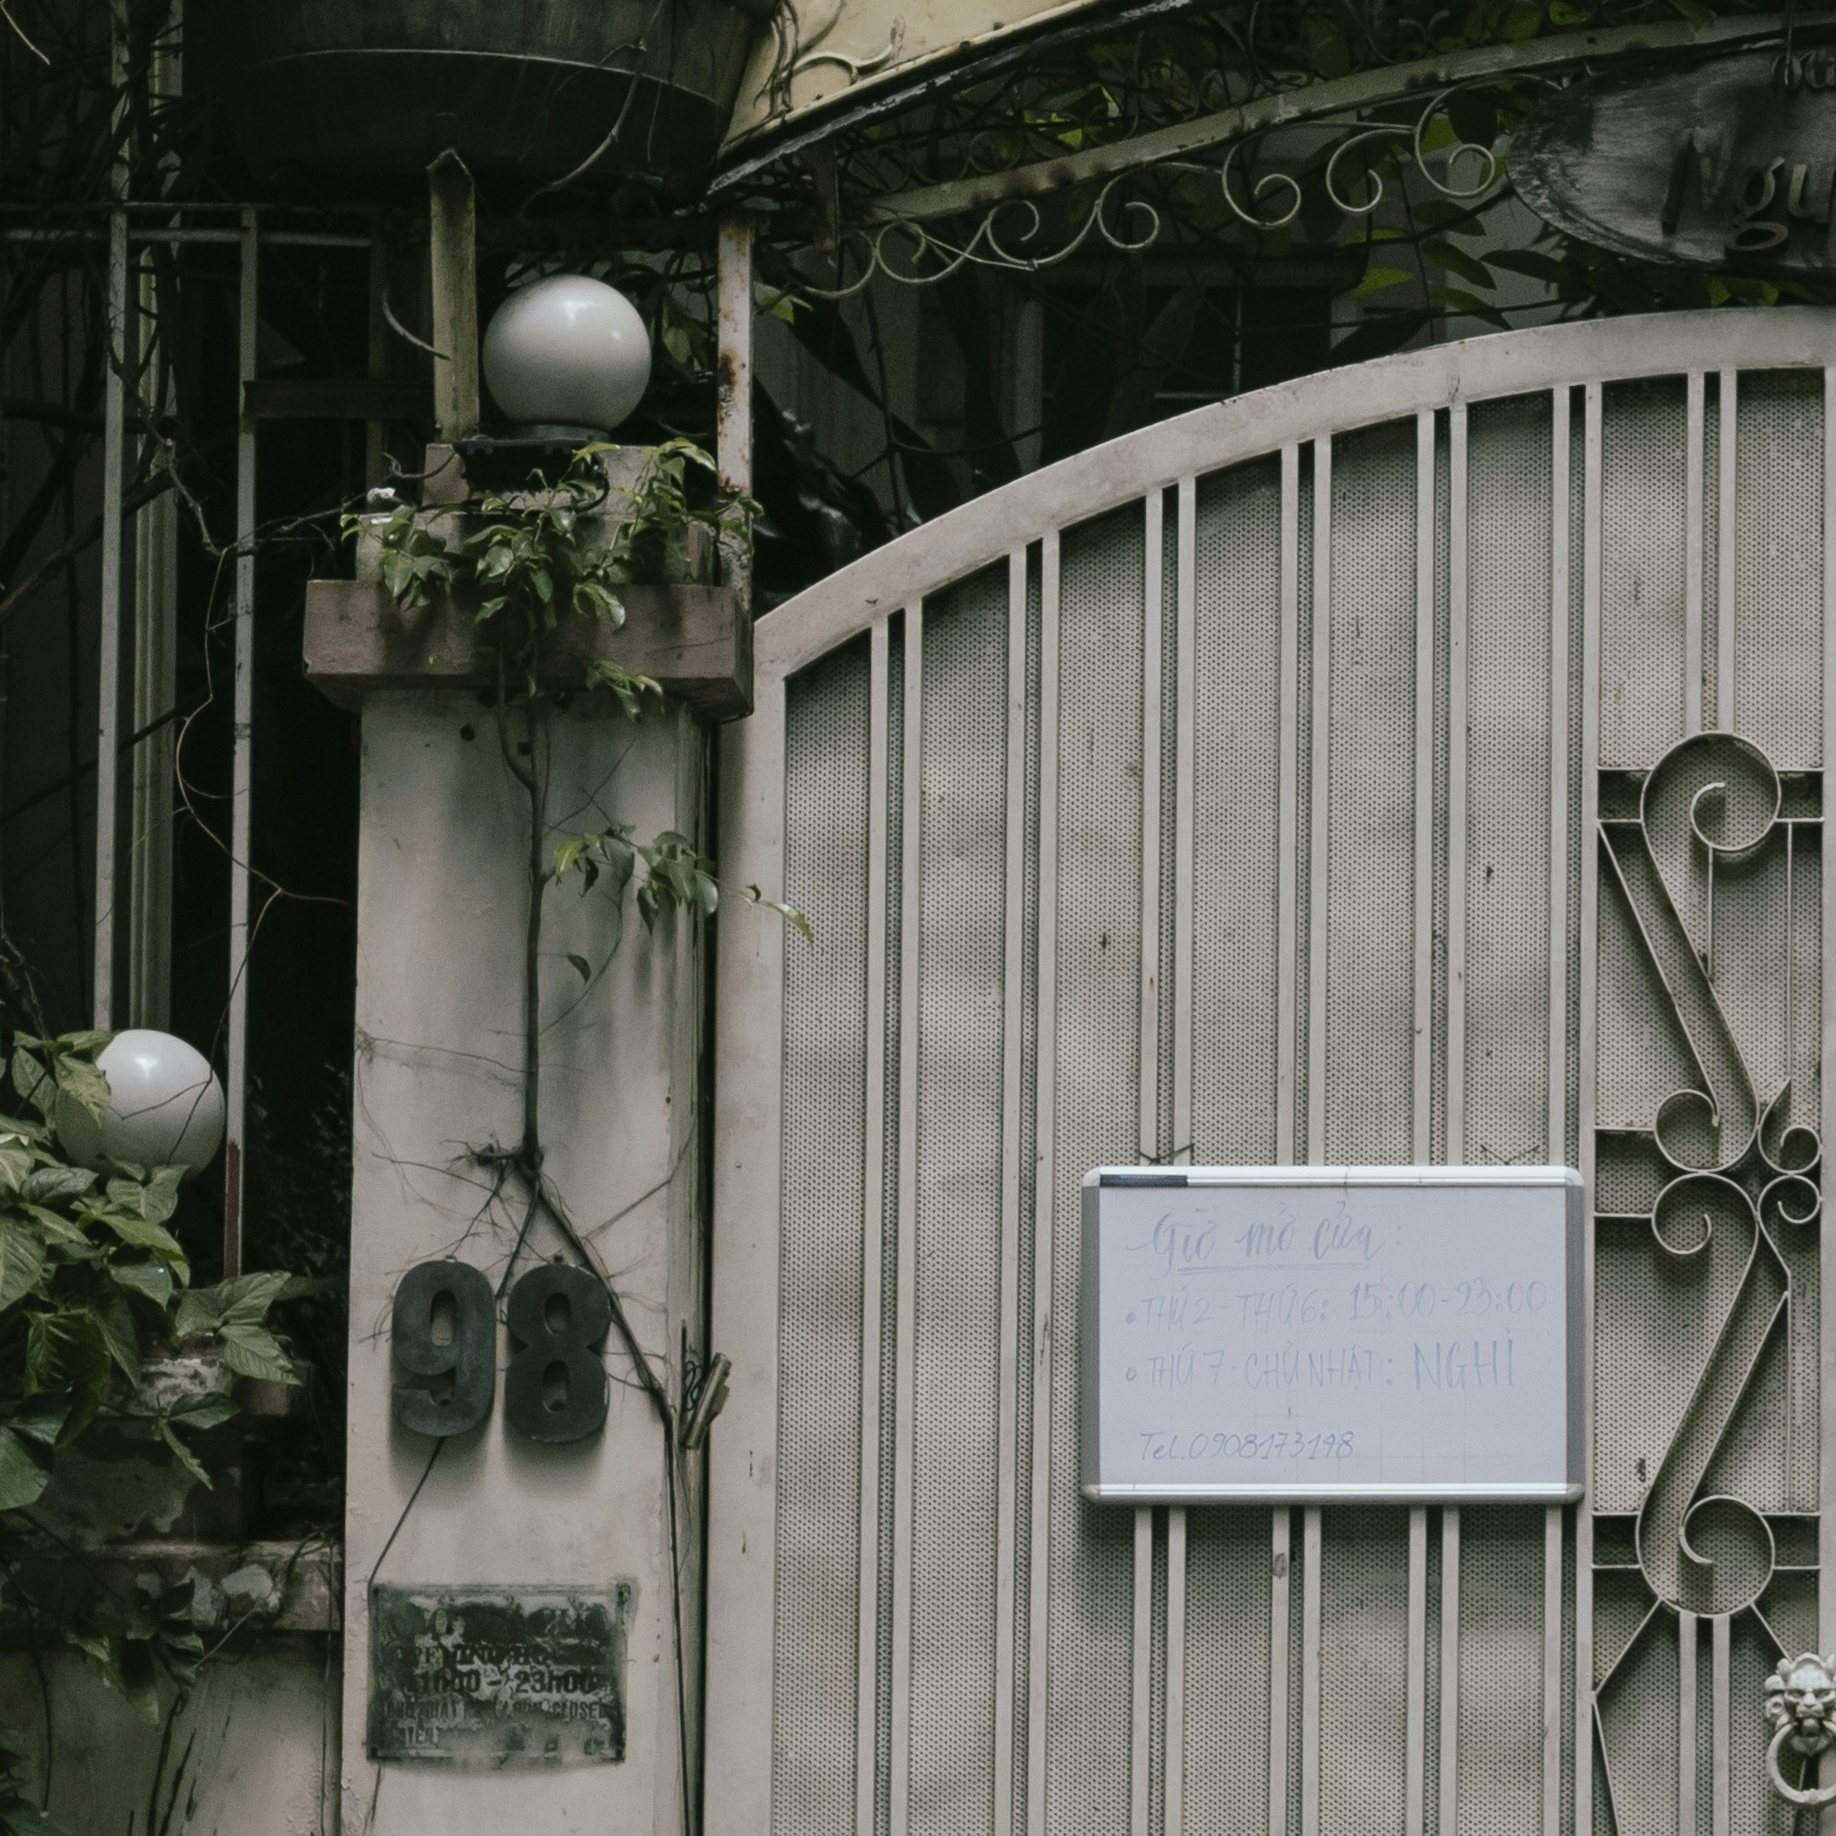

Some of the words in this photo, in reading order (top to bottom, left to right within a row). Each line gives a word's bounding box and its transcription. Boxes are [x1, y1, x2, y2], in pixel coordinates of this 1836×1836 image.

[1234, 1200, 1297, 1259] mở
[1192, 1297, 1217, 1326] 2
[392, 1259, 611, 1445] 98
[1202, 1348, 1226, 1387] 7
